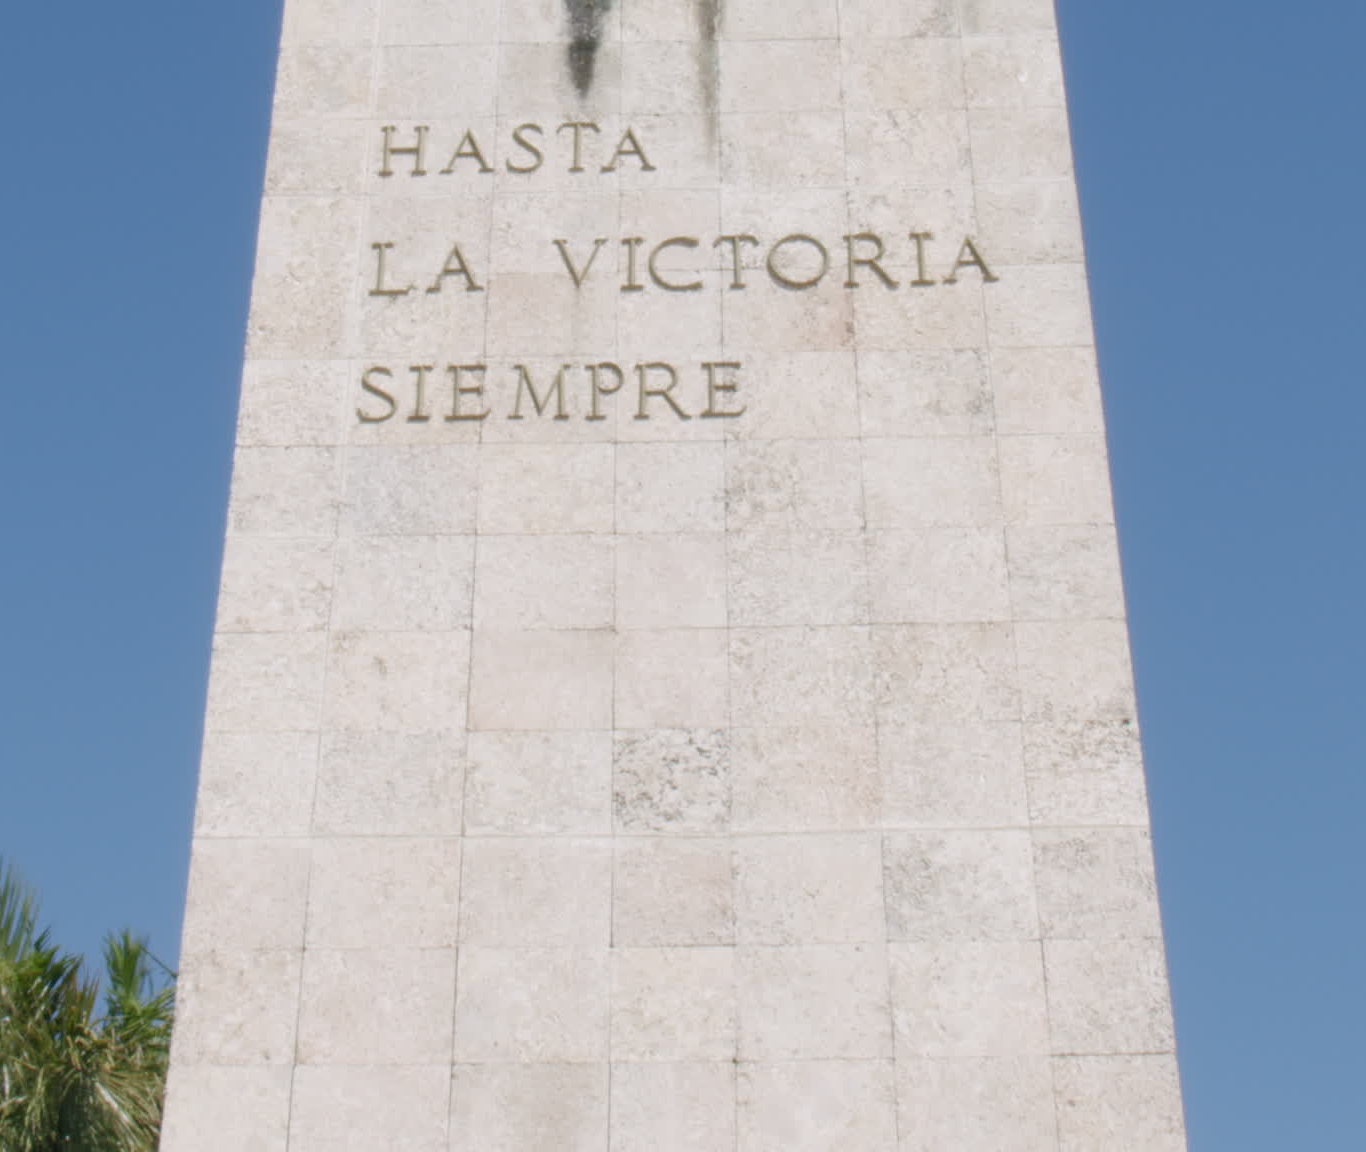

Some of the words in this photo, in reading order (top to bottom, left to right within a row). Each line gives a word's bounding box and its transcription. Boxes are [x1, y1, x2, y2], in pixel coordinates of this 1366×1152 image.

[377, 121, 657, 177] HASTA
[368, 241, 484, 297] LA
[553, 232, 1000, 292] VICTORIA
[355, 361, 748, 423] SIEMPRE
